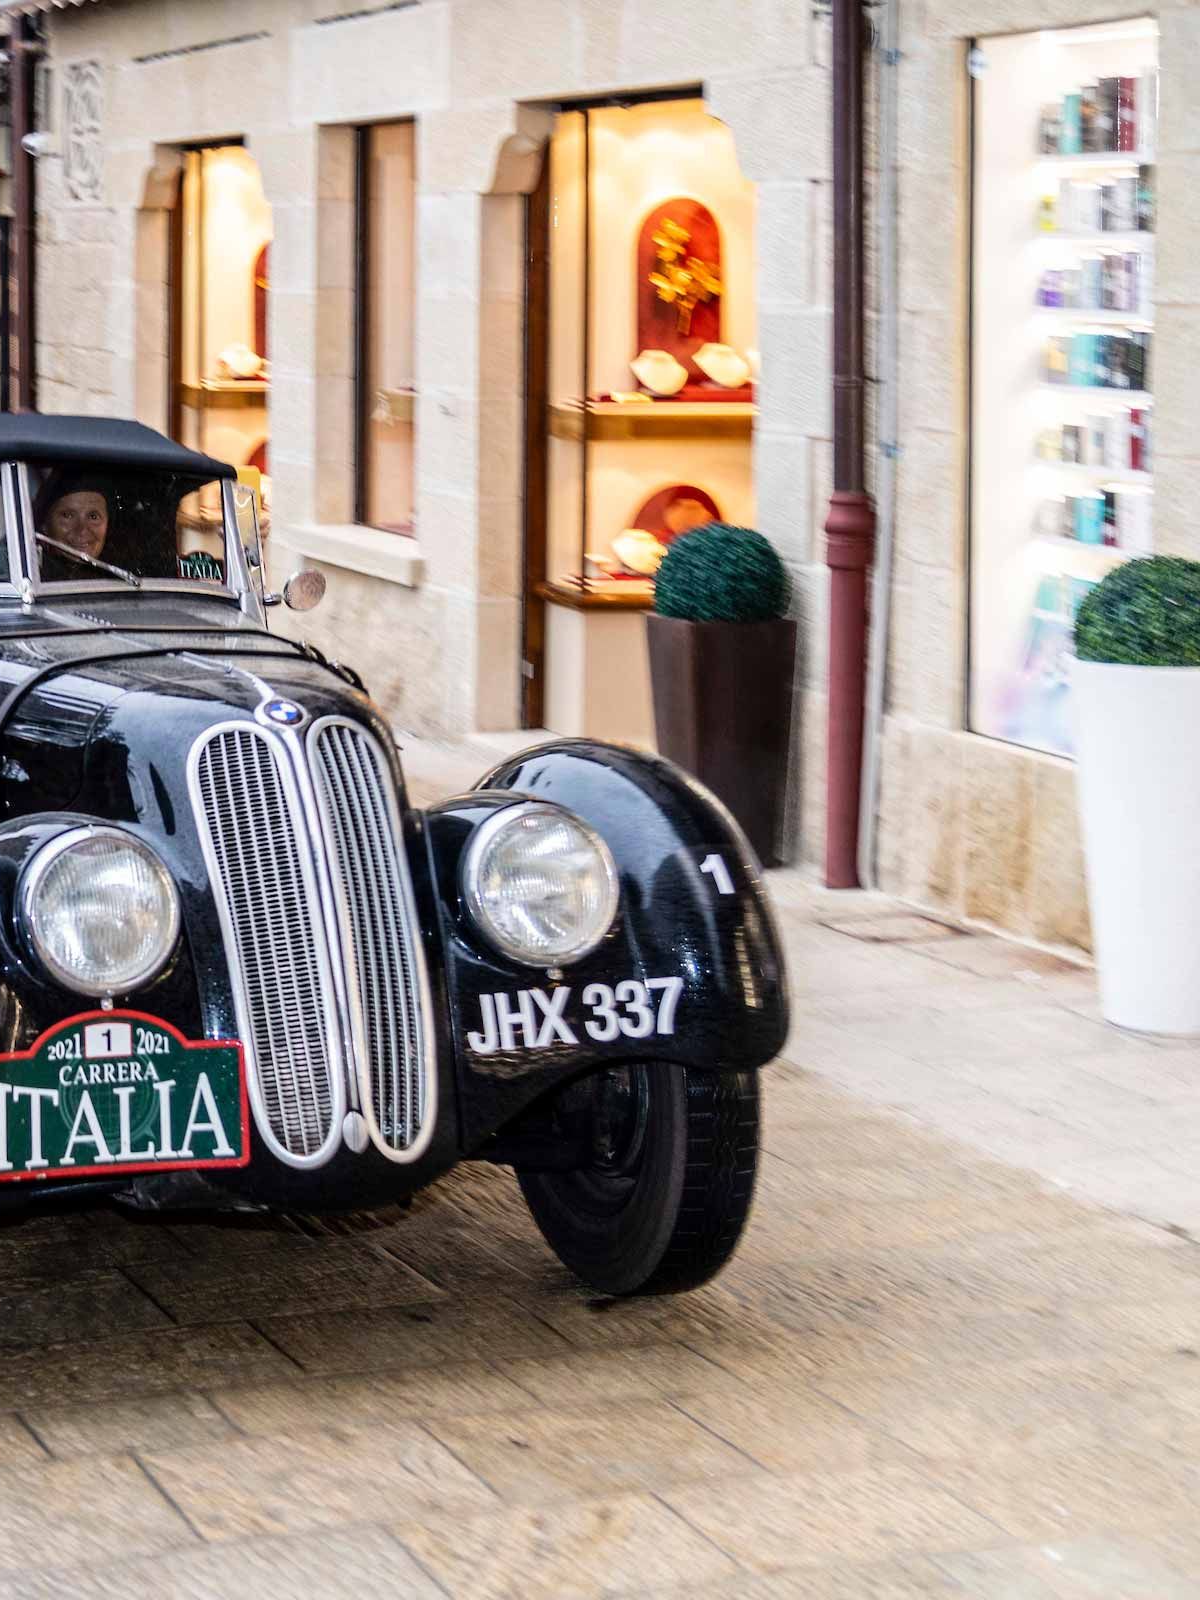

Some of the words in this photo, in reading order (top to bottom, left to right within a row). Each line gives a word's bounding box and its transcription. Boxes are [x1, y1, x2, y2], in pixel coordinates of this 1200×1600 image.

[180, 559, 223, 580] ITALIA
[698, 853, 736, 895] 1
[467, 986, 580, 1054] JHX
[581, 976, 684, 1042] 337
[47, 1033, 83, 1061] 2021
[101, 1029, 113, 1053] 1
[136, 1027, 170, 1055] 2021
[59, 1061, 160, 1085] CARRERA
